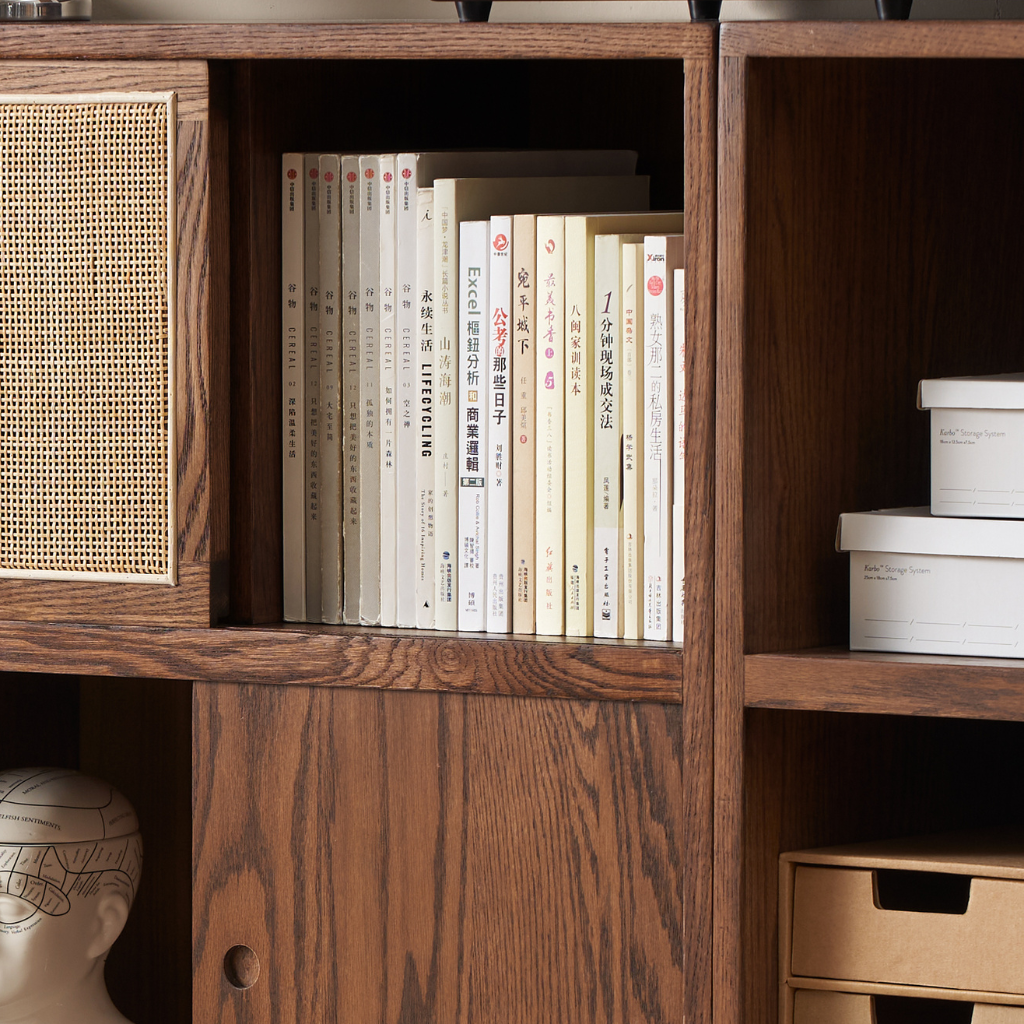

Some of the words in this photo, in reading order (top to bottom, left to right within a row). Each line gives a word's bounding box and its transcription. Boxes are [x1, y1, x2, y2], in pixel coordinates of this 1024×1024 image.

[287, 283, 297, 309] 谷物
[310, 286, 318, 312] 谷物
[325, 290, 334, 316] 谷物
[348, 290, 357, 316] 谷物
[365, 287, 374, 313] 谷物
[384, 287, 392, 313] 谷物
[402, 283, 411, 309] 谷物
[468, 267, 481, 315] Excel
[421, 290, 433, 352] 永续生活
[516, 267, 530, 355] 宛平城下
[288, 327, 296, 369] CEREAL
[349, 330, 357, 373] CEREAL
[384, 327, 392, 370] CEREAL
[402, 327, 410, 370] CEREAL
[599, 290, 614, 429] 1分钟现场成交法
[492, 307, 509, 425] 公考的那些日子
[421, 363, 432, 457] LIFECYCLING
[960, 429, 984, 439] Storage
[984, 430, 1007, 439] System
[884, 565, 907, 576] Storage
[908, 566, 931, 576] System
[20, 816, 62, 832] SENTIMENTS
